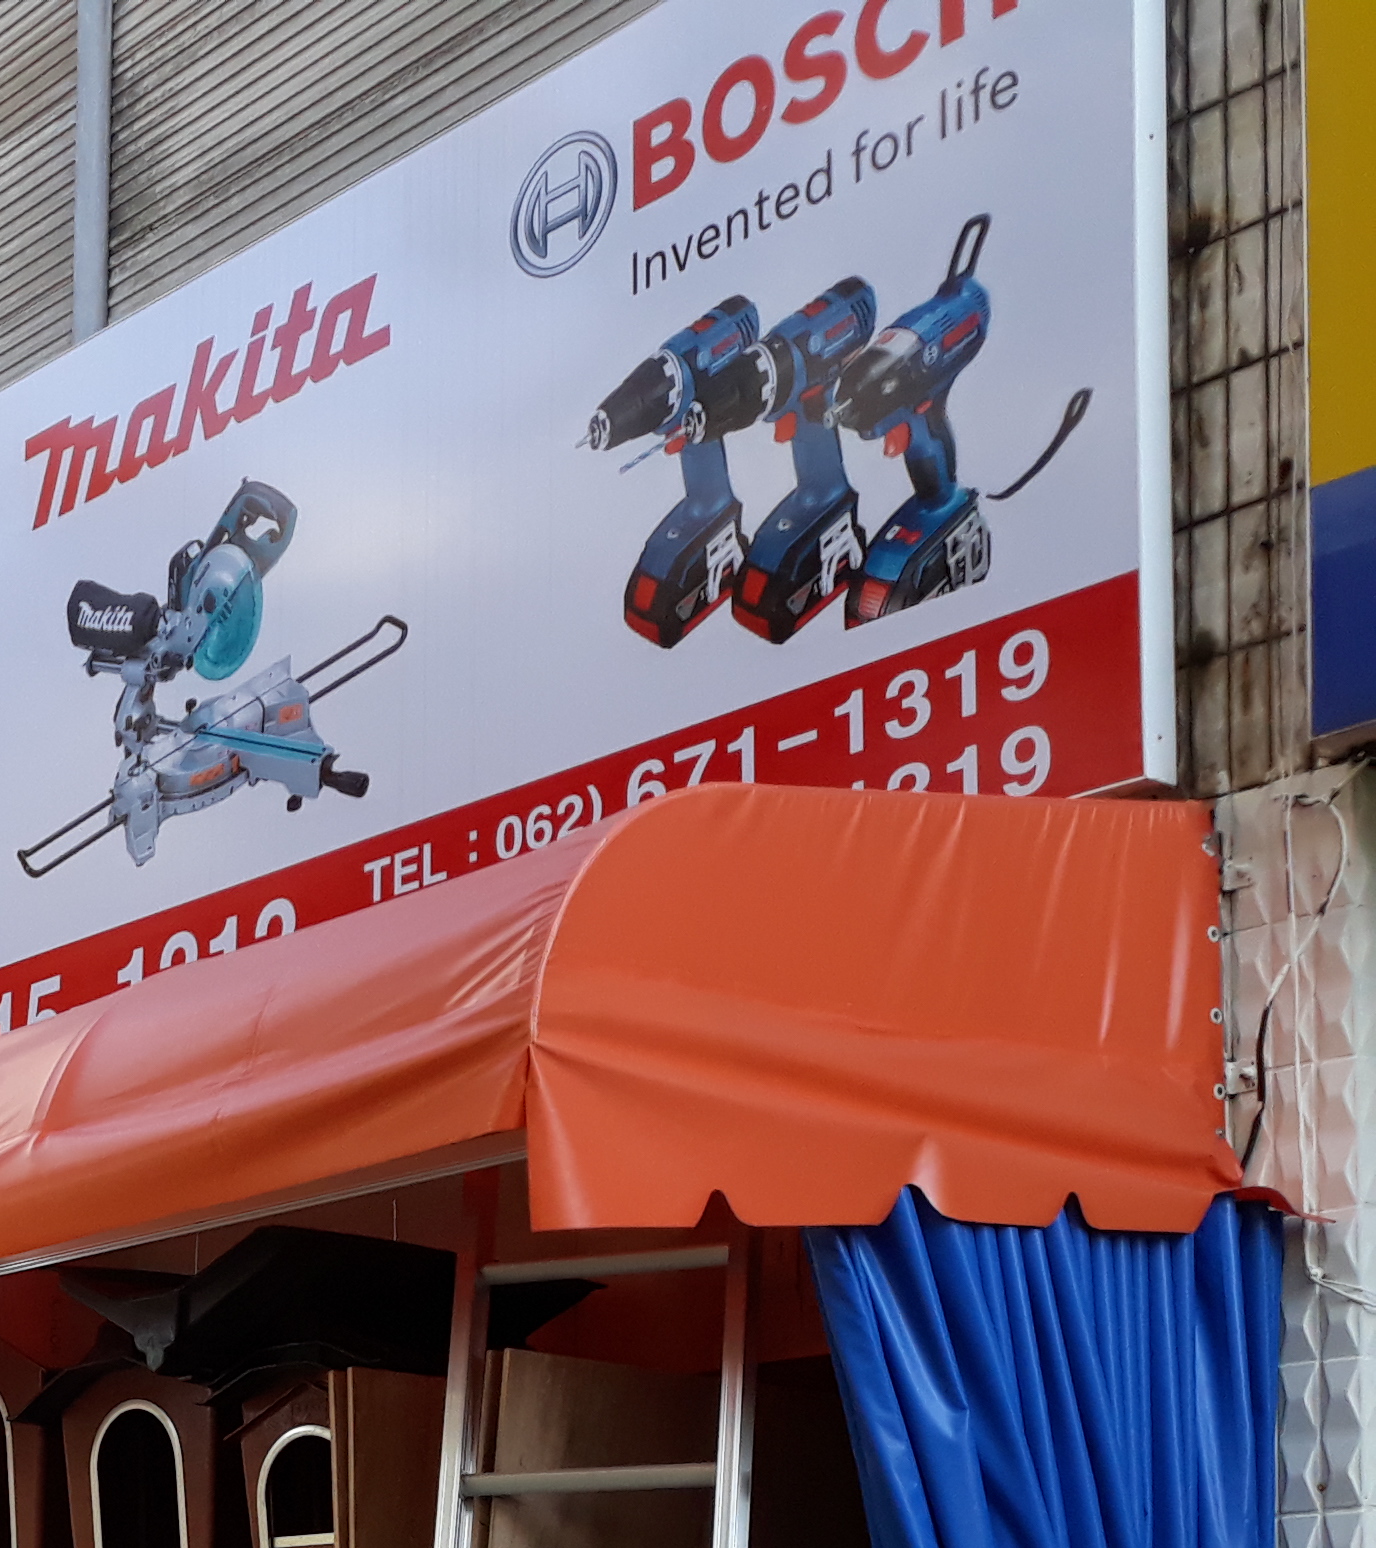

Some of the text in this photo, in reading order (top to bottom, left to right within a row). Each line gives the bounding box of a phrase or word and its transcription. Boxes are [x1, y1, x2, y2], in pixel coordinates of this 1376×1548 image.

[631, 66, 1019, 296] Invented for life
[363, 842, 448, 903] TEL
